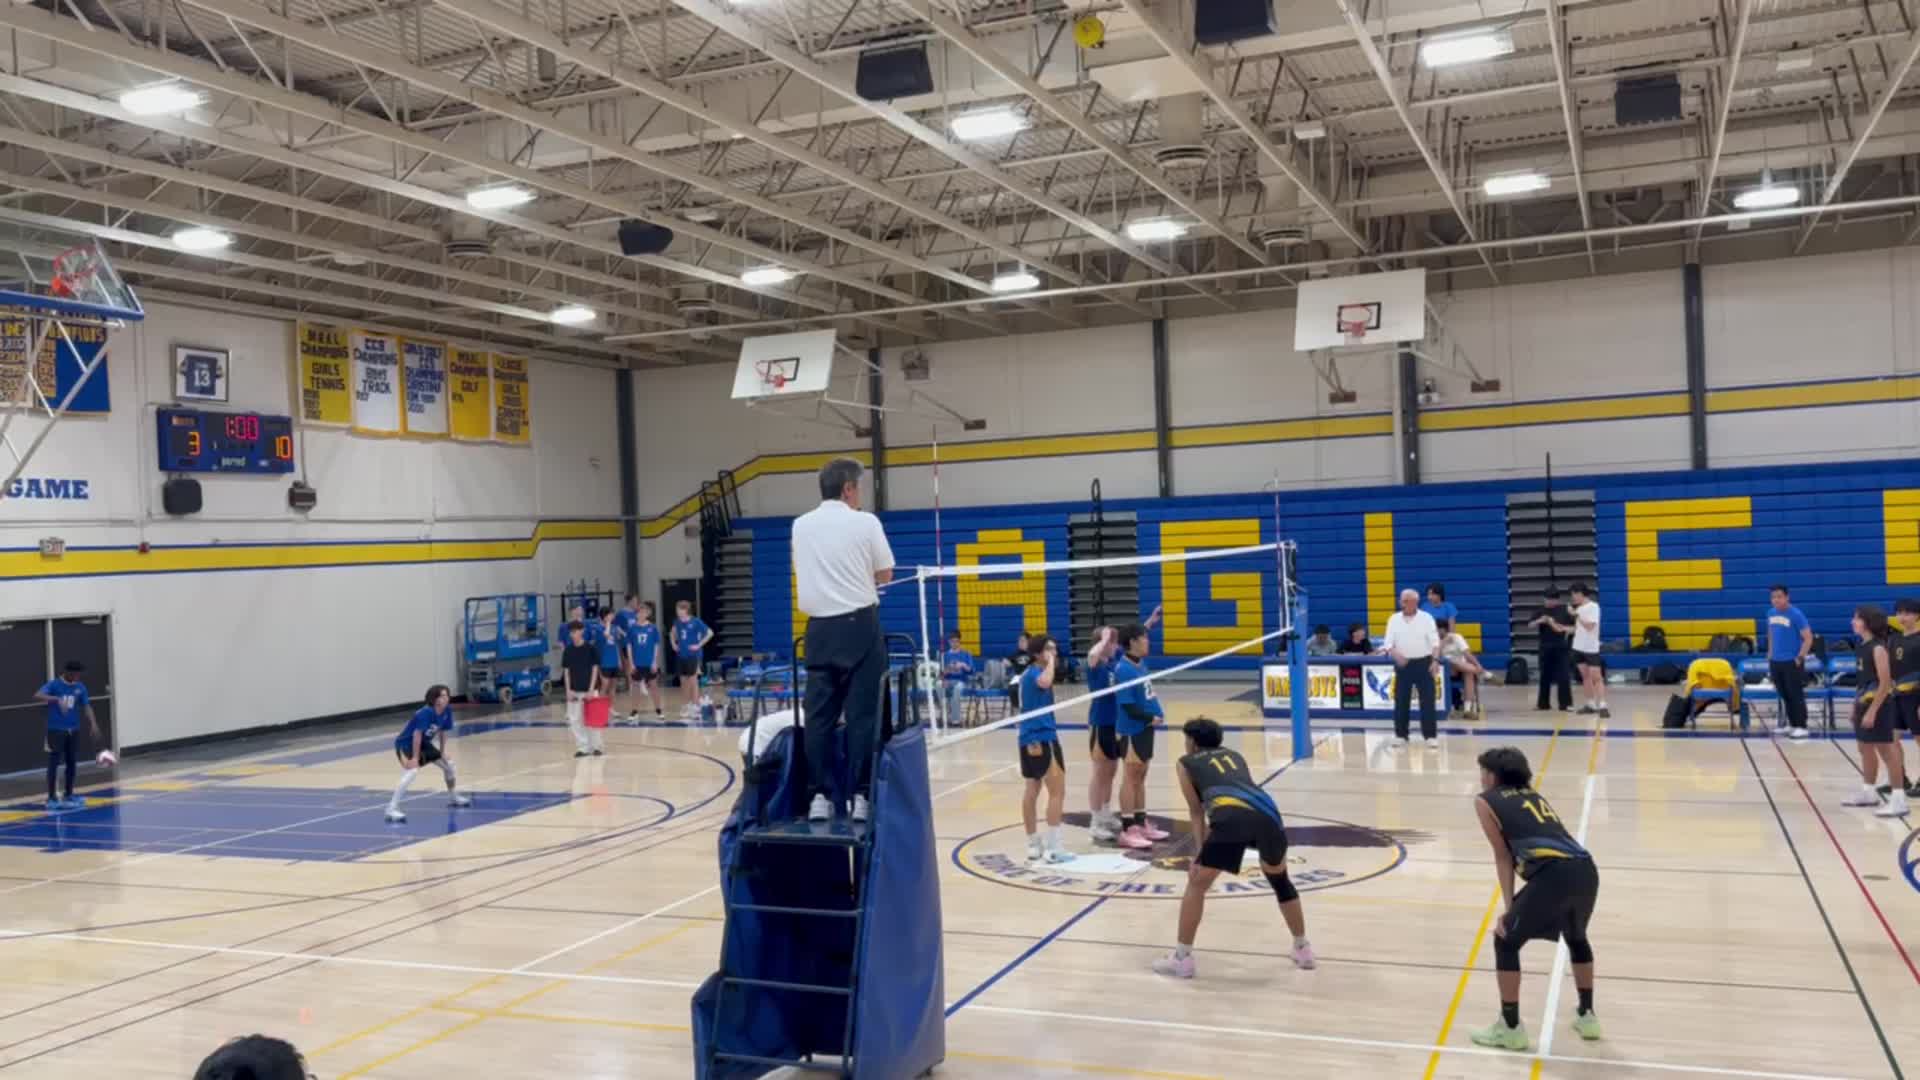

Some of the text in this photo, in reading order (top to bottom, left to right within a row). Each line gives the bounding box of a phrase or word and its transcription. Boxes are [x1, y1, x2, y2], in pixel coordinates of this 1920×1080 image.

[194, 369, 210, 387] 13
[312, 362, 340, 376] GIRLS
[310, 376, 345, 391] TENNIS
[362, 379, 392, 394] TRACK
[187, 431, 200, 456] 3
[275, 435, 293, 460] 10
[5, 478, 89, 500] GAME
[1209, 755, 1238, 774] 11
[1522, 799, 1560, 823] 14
[1096, 880, 1177, 894] THE
